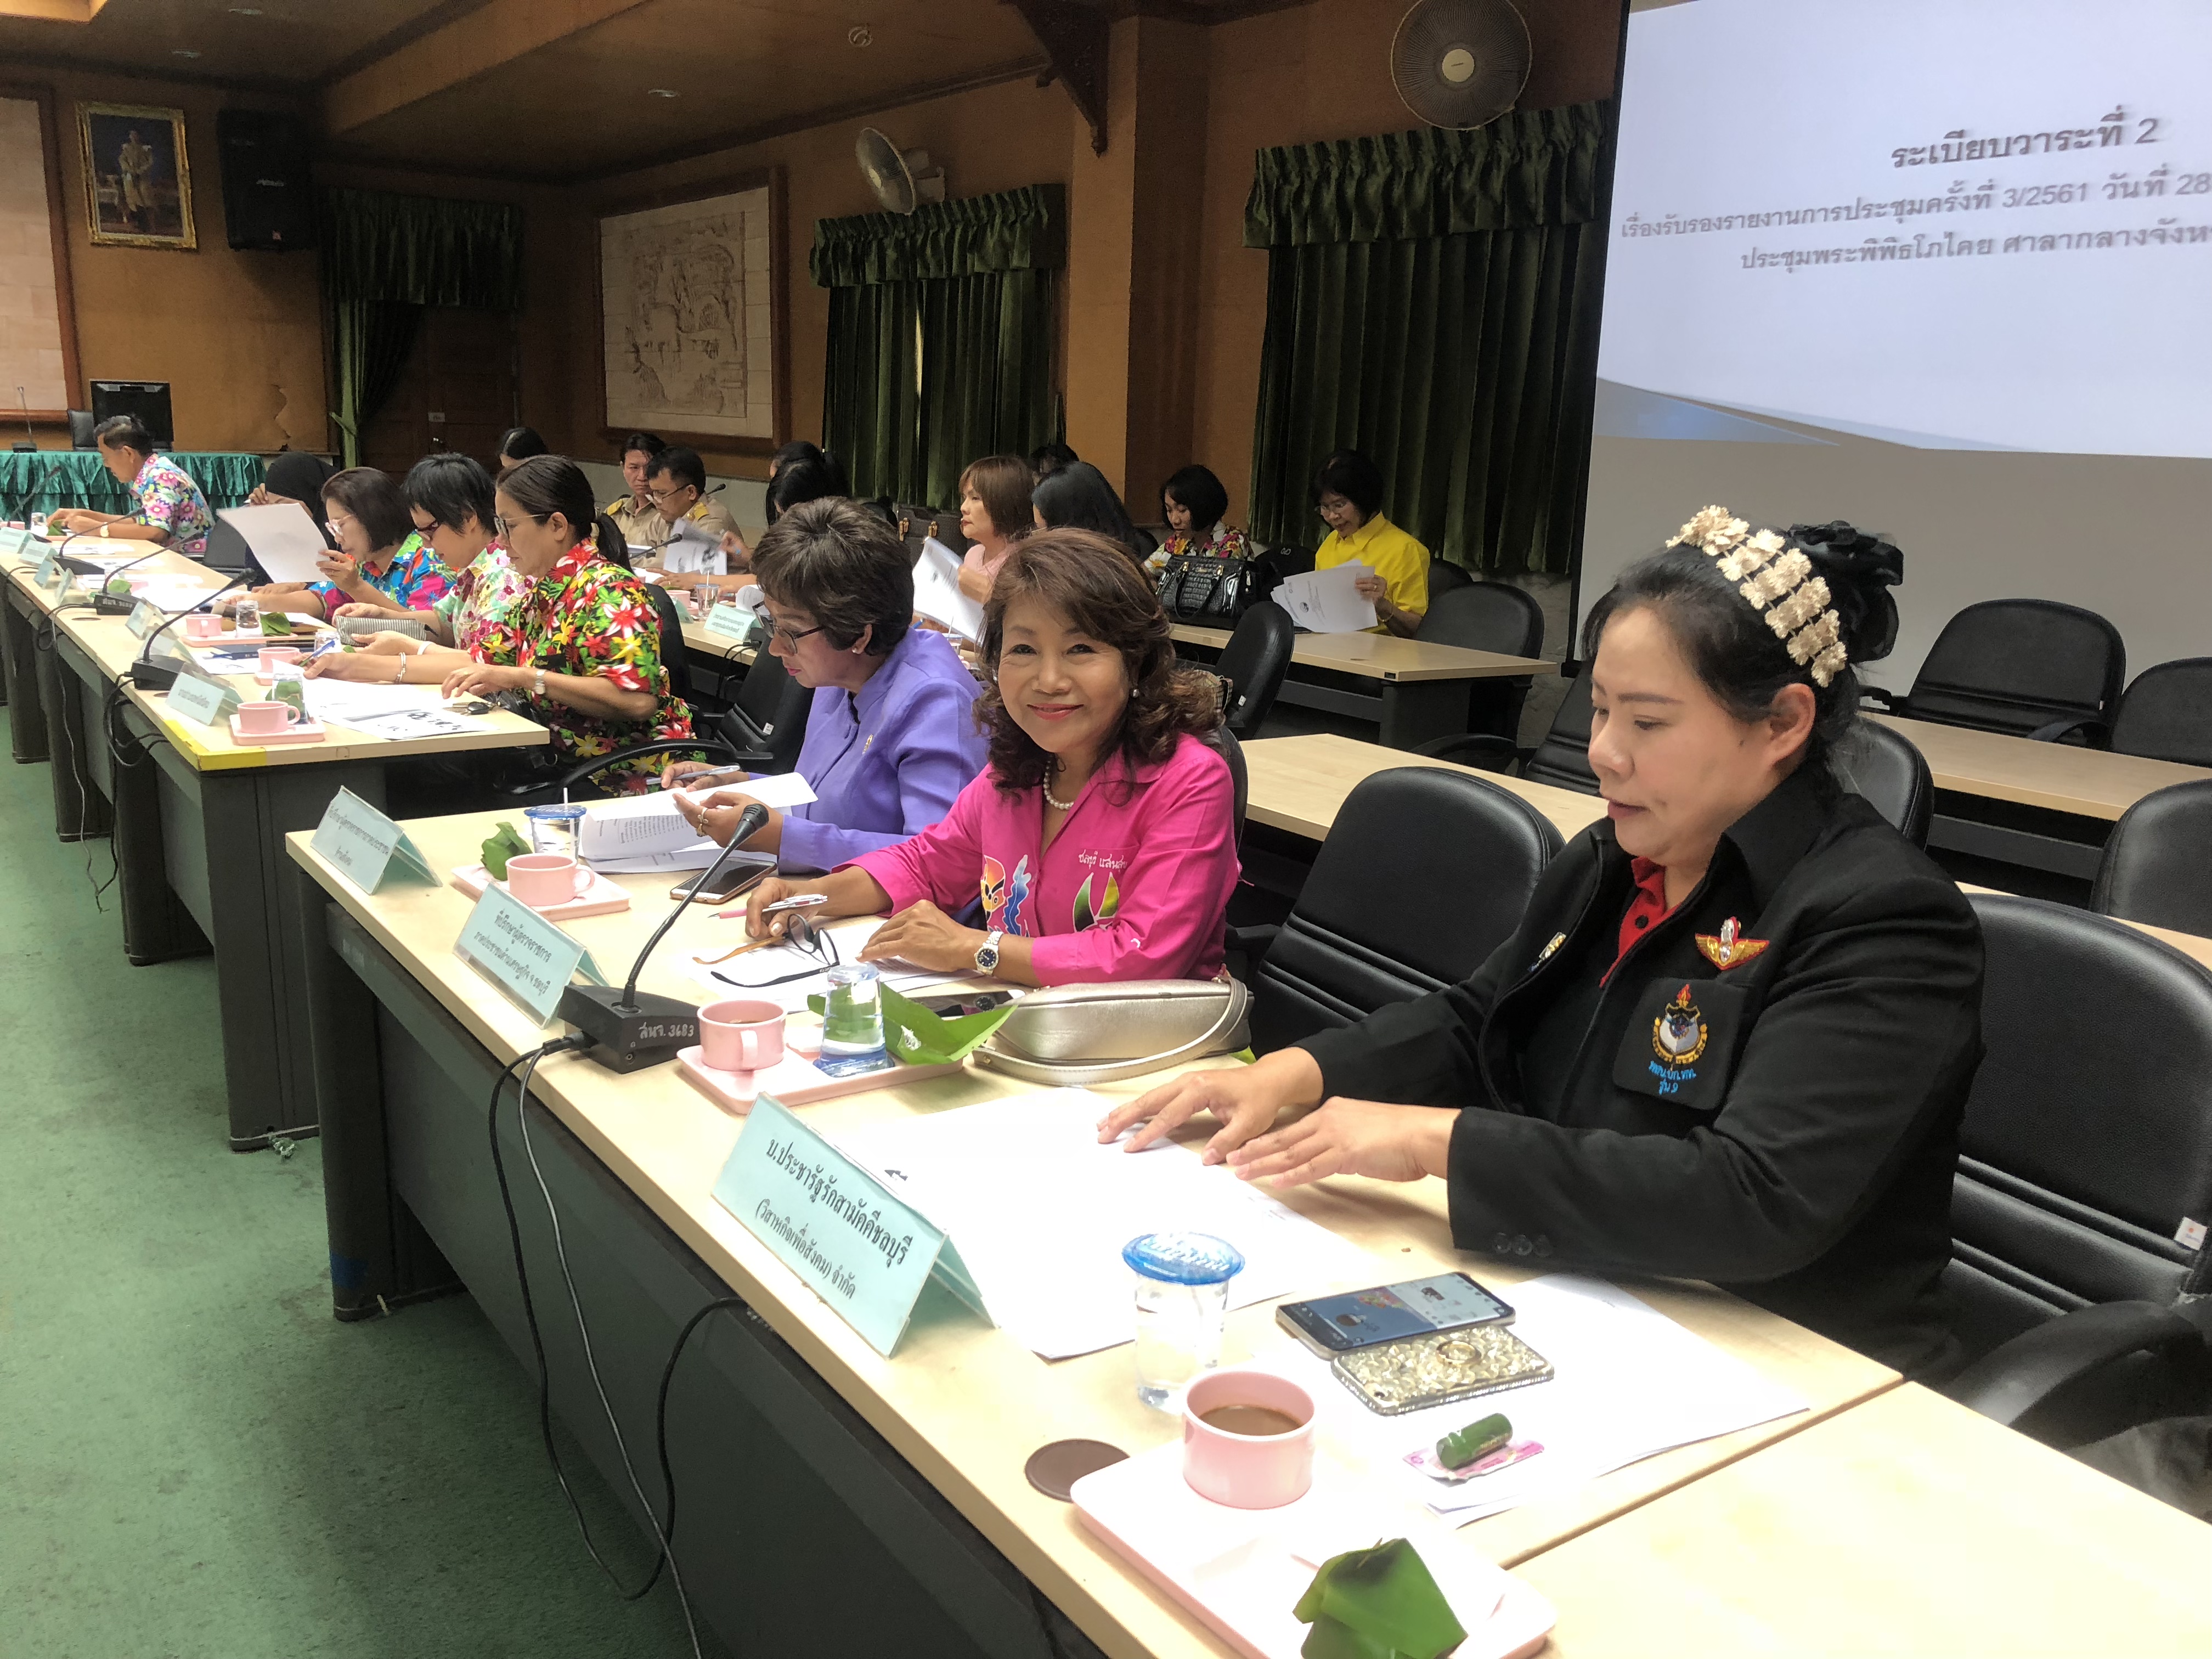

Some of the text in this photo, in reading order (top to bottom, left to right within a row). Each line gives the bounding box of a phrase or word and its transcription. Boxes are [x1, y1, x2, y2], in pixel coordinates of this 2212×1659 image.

[1891, 104, 2159, 168] ระเบียบวาระที่ 2
[1621, 162, 2212, 238] เรื่องรับรองรายงานการประชุมครั้งที่ 3/2561 วันที่ 28
[1741, 217, 2212, 274] ประชุมพระพิพิธโภไคย ศาลากลางจังห
[668, 1023, 695, 1037] 3683
[766, 1138, 914, 1268] บ.ประชารัฐรักสามัคคีชลบุรี
[755, 1198, 856, 1300] (วิสาหกิจเพื่อสังคม) จำกัด
